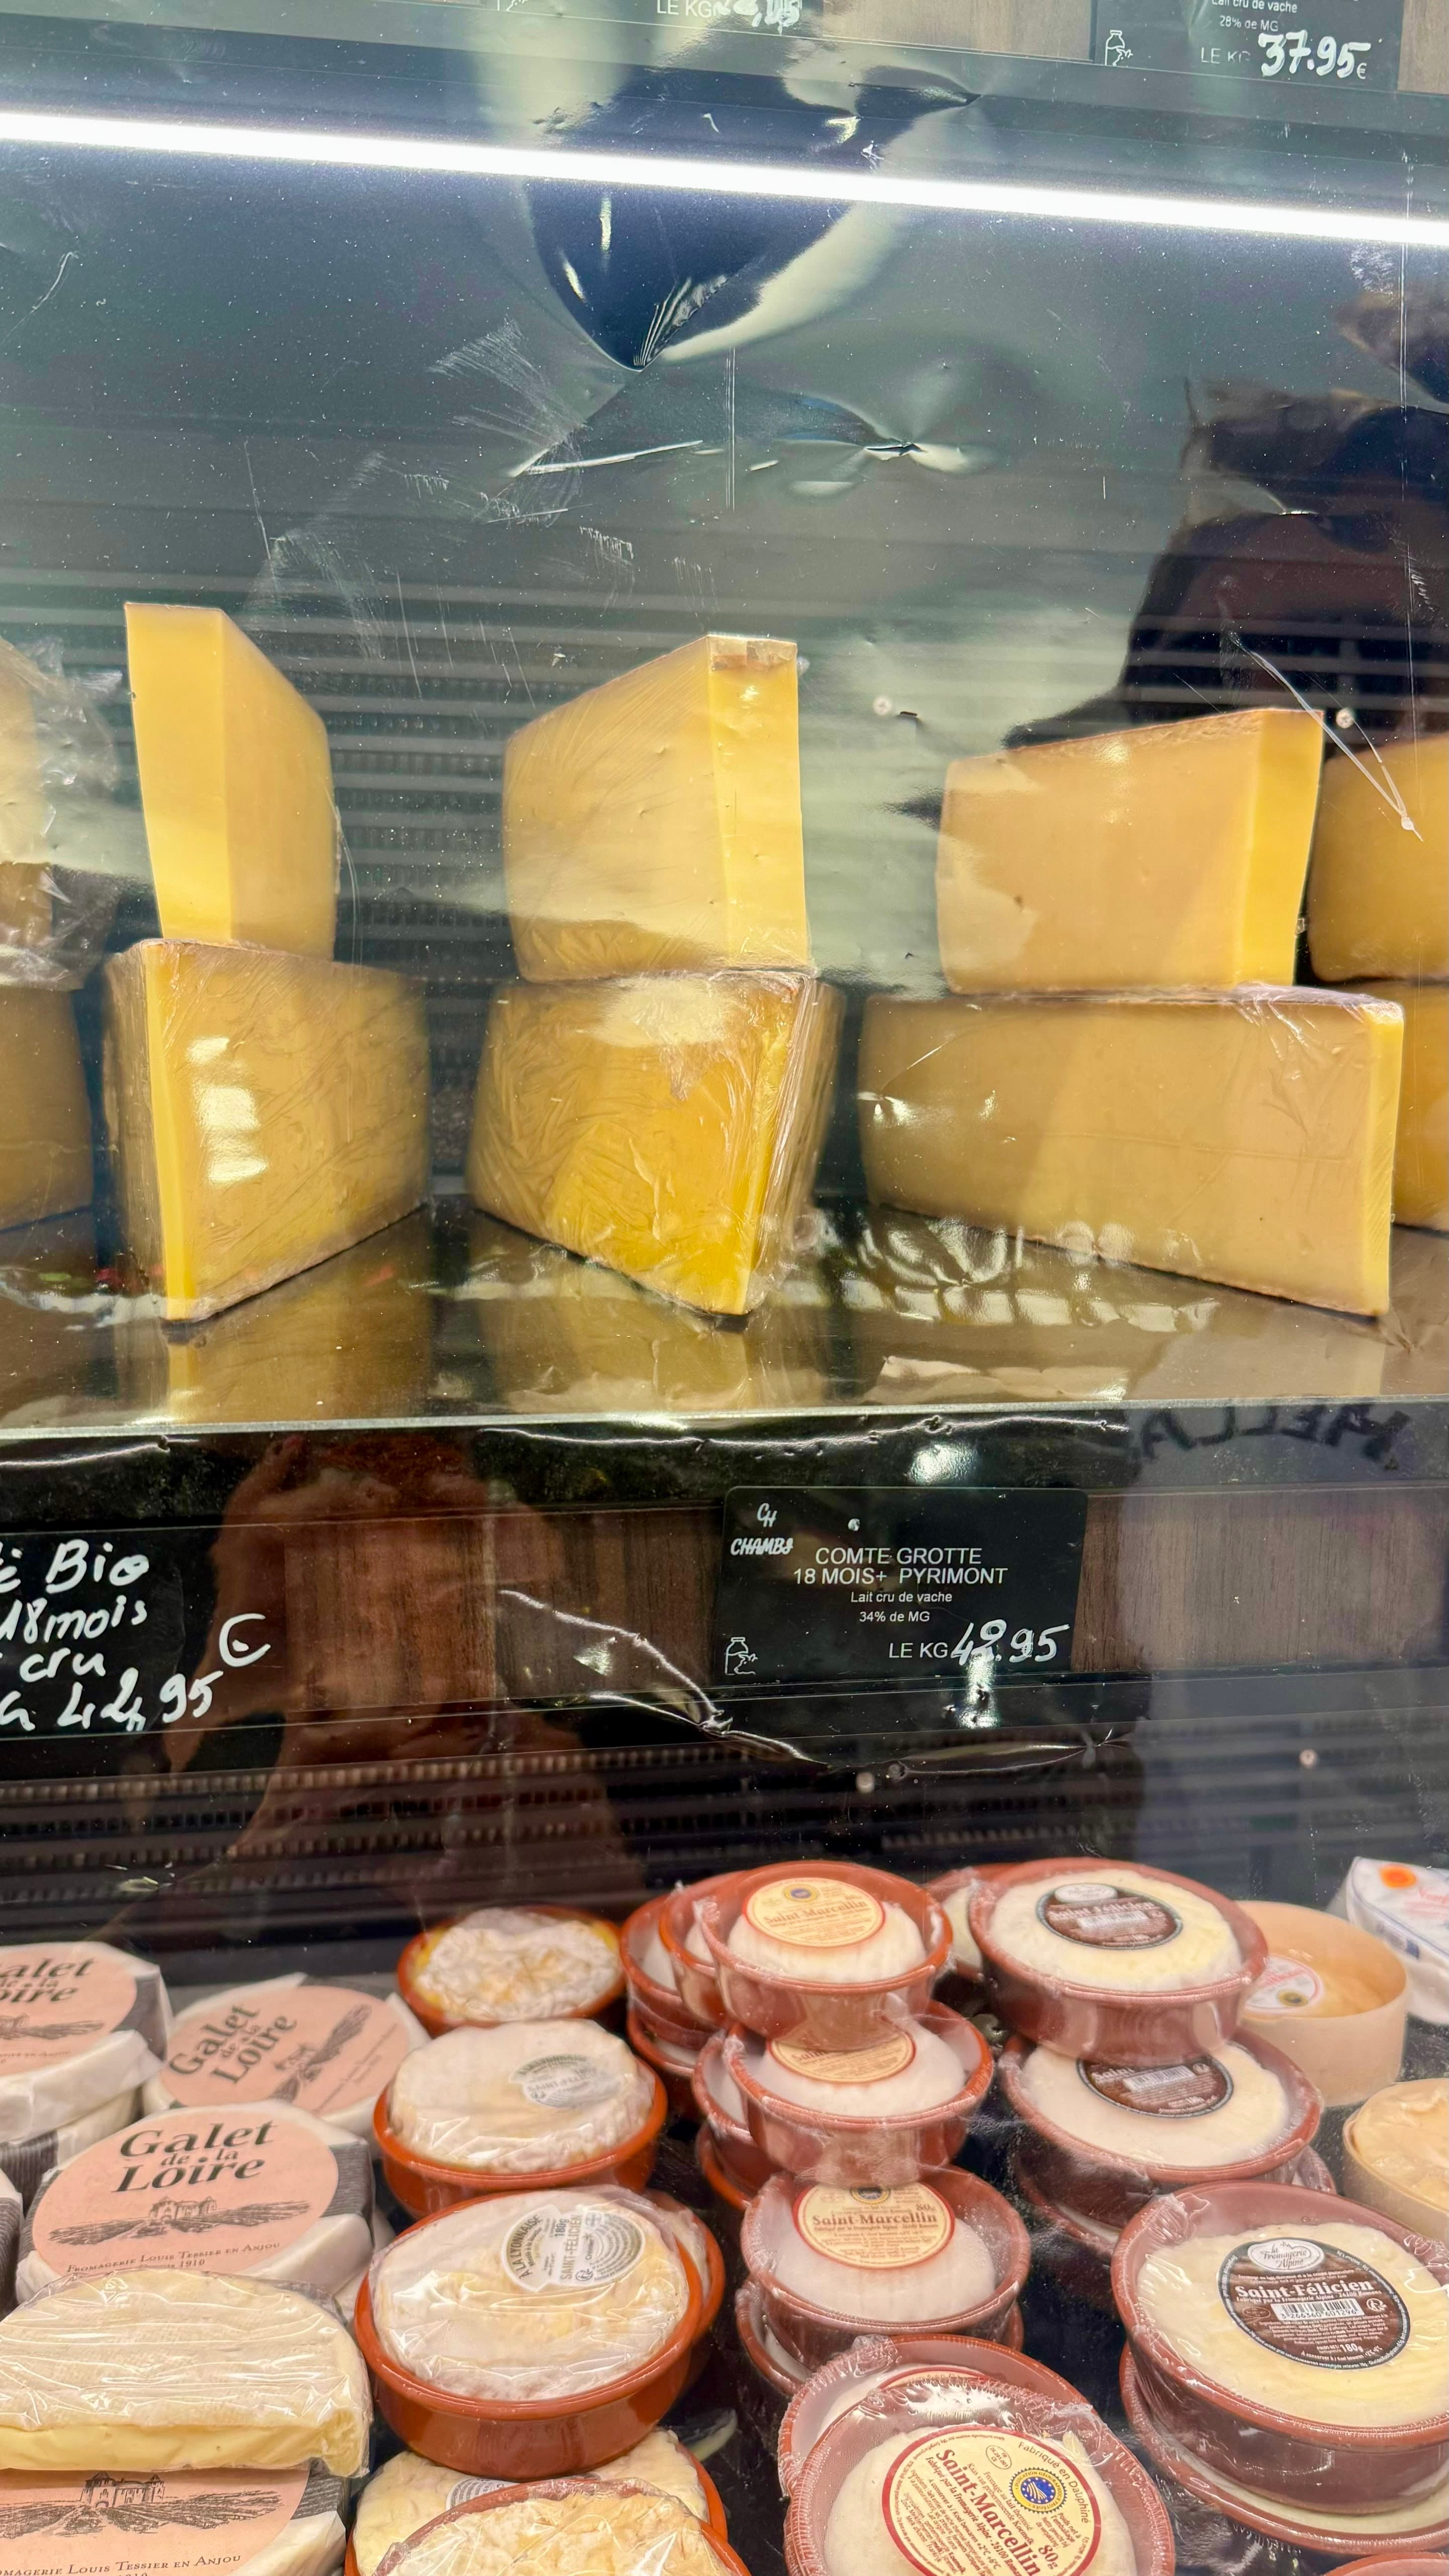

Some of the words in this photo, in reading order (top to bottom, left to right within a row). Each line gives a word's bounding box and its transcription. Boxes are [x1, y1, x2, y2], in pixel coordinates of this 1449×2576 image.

[1267, 1, 1298, 13] vache
[1220, 16, 1242, 28] 28%
[1244, 20, 1257, 29] de
[1260, 20, 1279, 31] MG
[1201, 47, 1221, 64] LE
[815, 1547, 891, 1565] COMTE
[897, 1547, 982, 1565] GROTTE
[45, 1539, 150, 1594] Bio
[793, 1568, 816, 1584] 18
[822, 1567, 887, 1584] MOIS+
[899, 1567, 1008, 1585] PYRIMONT
[850, 1591, 873, 1603] Lait
[876, 1593, 895, 1602] cru
[899, 1591, 914, 1602] de
[917, 1592, 953, 1602] vache
[859, 1611, 886, 1622] 34%
[889, 1611, 905, 1622] de
[908, 1611, 930, 1622] MG
[889, 1643, 914, 1658] LE
[919, 1642, 948, 1658] KG
[20, 1648, 106, 1682] cru
[0, 1957, 97, 1977] alet
[0, 1987, 79, 2003] oire
[170, 2005, 260, 2075] Galet
[211, 2015, 298, 2085] Loire
[120, 2119, 278, 2157] Galet
[160, 2153, 191, 2166] de
[216, 2148, 238, 2161] la
[111, 2159, 266, 2193] Loire
[555, 2218, 570, 2237] 180g
[812, 2212, 939, 2226] Saint-Marcellin
[1235, 2280, 1375, 2299] Saint-Félicien
[1340, 2343, 1363, 2353] 180g
[1018, 2442, 1060, 2468] Fabriqué
[1059, 2468, 1071, 2480] en
[936, 2445, 1045, 2576] Saint-Marcellin
[1006, 2499, 1016, 2510] lait
[941, 2477, 952, 2488] par
[952, 2491, 981, 2523] Fromagerie
[974, 2520, 993, 2541] Alpine
[991, 2540, 1009, 2559] 26100
[1058, 2512, 1071, 2526] Poids
[1069, 2525, 1078, 2534] net
[1013, 2520, 1035, 2545] Koemelk
[68, 2564, 110, 2574] LOUIS
[115, 2561, 169, 2571] TESSIER
[194, 2555, 242, 2567] ANJOU
[1036, 2542, 1063, 2570] 80g
